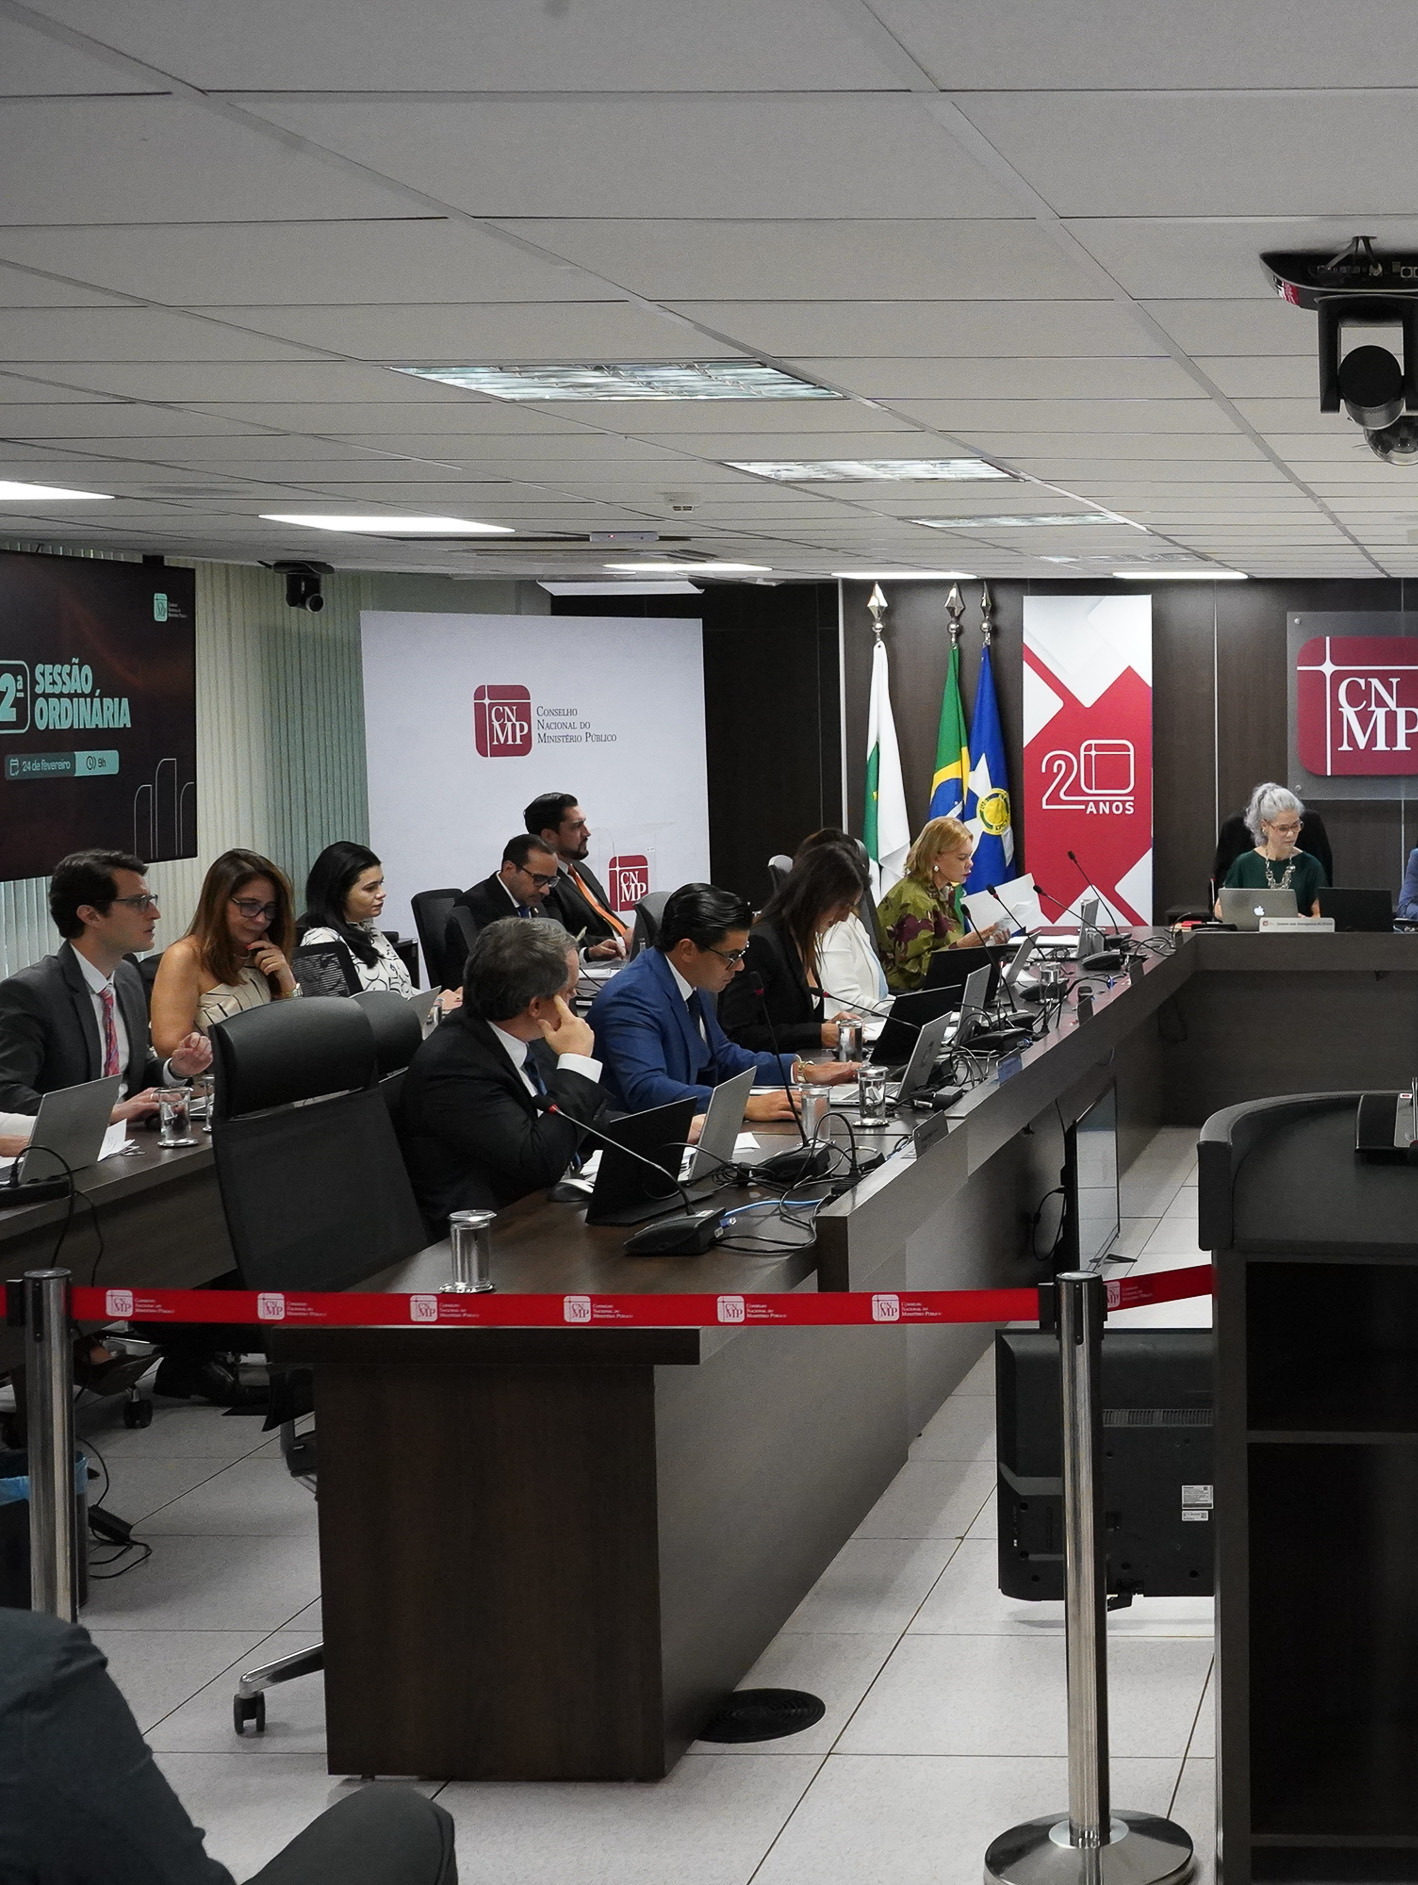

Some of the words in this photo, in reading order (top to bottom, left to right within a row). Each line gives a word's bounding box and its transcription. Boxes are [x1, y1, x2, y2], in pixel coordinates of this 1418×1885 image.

[35, 657, 93, 694] SESSÃO
[1337, 677, 1402, 711] CN
[34, 688, 132, 730] ORDINÁRIA
[491, 705, 517, 724] CN
[536, 706, 578, 717] CONSELHO
[491, 721, 529, 745] MP
[537, 719, 577, 730] NACIONAL
[537, 731, 583, 744] MINISTÉRIO
[585, 731, 617, 743] PÚBLICO
[22, 760, 31, 772] 24
[32, 759, 41, 771] de
[41, 758, 71, 771] fevereiro
[1086, 801, 1135, 815] ANOS
[620, 871, 639, 886] CN
[621, 882, 647, 902] MP
